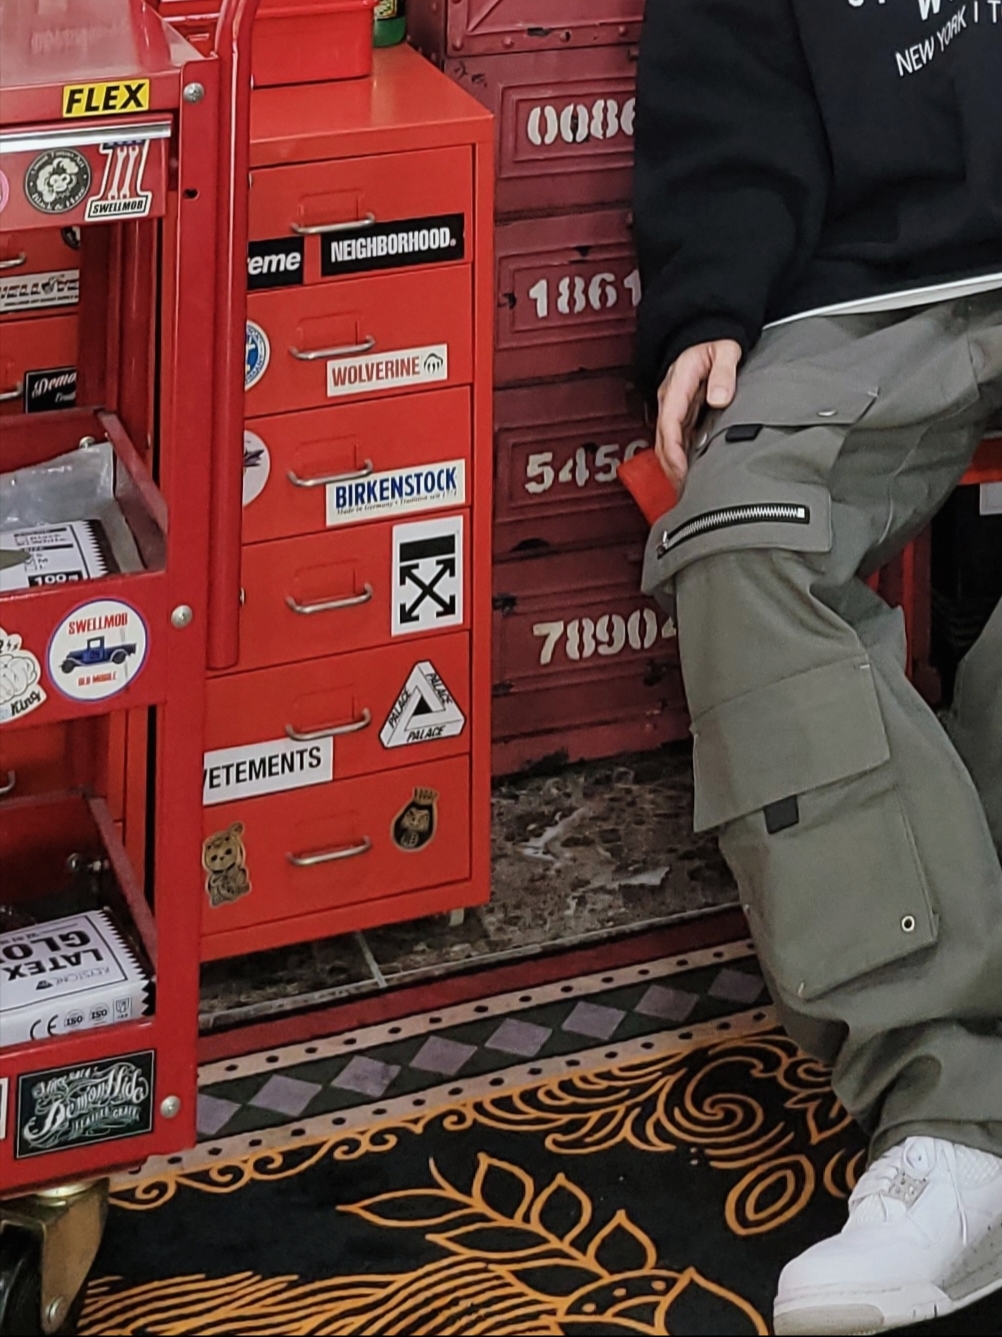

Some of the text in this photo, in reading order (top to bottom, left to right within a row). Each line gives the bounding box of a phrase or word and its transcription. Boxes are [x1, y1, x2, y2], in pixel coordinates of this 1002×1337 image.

[895, 35, 935, 76] NEW
[936, 5, 967, 52] YORK
[65, 83, 146, 114] FLEX
[248, 251, 301, 275] eme
[32, 371, 77, 399] Demo
[332, 356, 420, 387] WOLVERINE
[335, 467, 457, 509] BIRKENSTOCK
[11, 690, 41, 716] King
[426, 672, 453, 705] PALACE
[388, 688, 412, 729] PALACE
[406, 725, 446, 743] PALACE
[0, 930, 91, 962] GLO
[7, 948, 103, 982] LATEX
[66, 1015, 84, 1026] ISO
[91, 1008, 108, 1020] ISO
